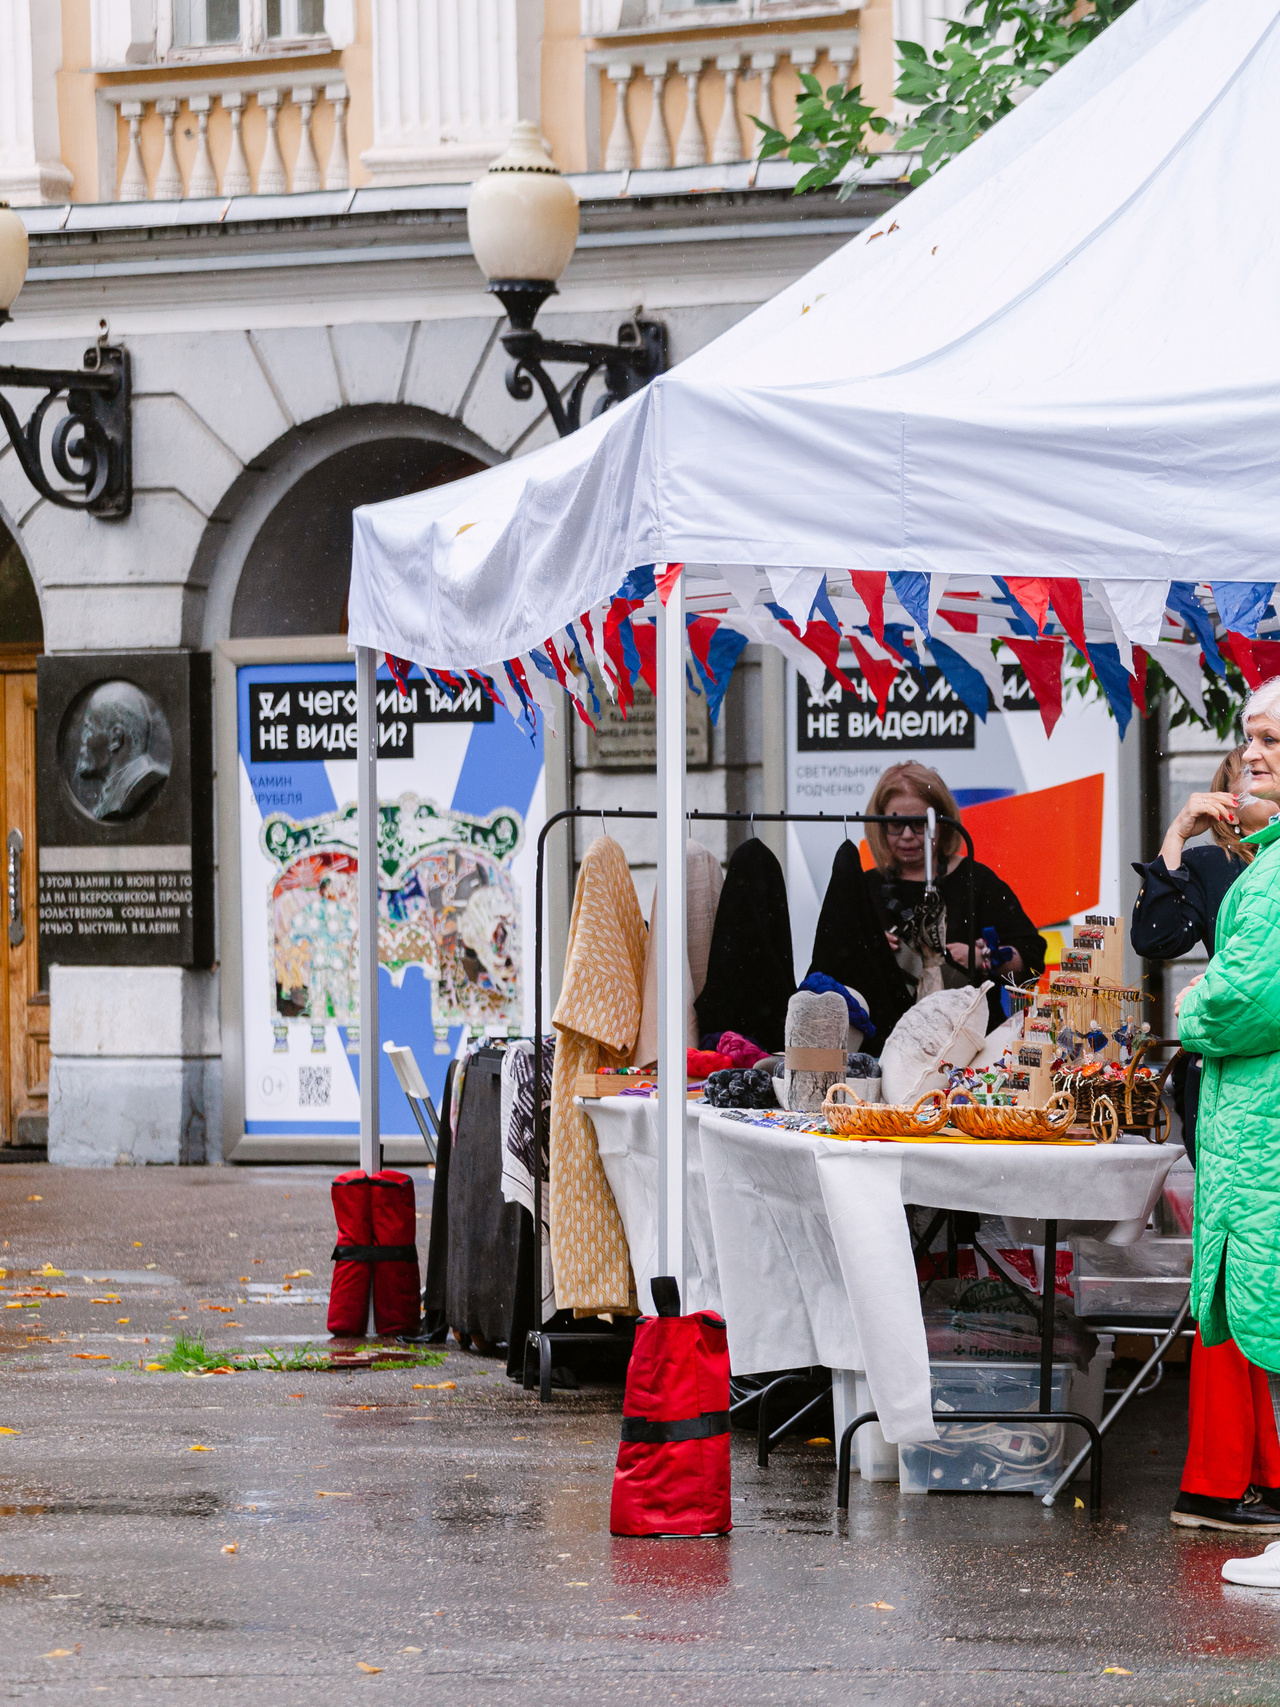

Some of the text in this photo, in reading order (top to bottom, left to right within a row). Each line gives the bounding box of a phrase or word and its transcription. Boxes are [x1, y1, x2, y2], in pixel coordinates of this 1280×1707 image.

[258, 691, 291, 720] ДА
[807, 712, 840, 738] НЕ
[259, 724, 289, 750] НЕ
[250, 776, 292, 788] КАМИН
[797, 783, 865, 797] РОДЧЕНКО
[47, 875, 72, 888] ЭТОМ
[75, 875, 111, 888] ЗДАНИИ
[114, 876, 123, 888] 16
[126, 875, 155, 888] ИЮНЯ
[158, 875, 176, 888] 1921
[40, 892, 52, 904] ДА
[54, 892, 66, 904] НА
[40, 906, 114, 919] ВОЛЬСТВЕННОМ
[121, 906, 180, 919] СОВЕЩАНИИ
[40, 921, 73, 934] РЕЧЬЮ
[77, 921, 128, 934] ВЫСТУПИЛ
